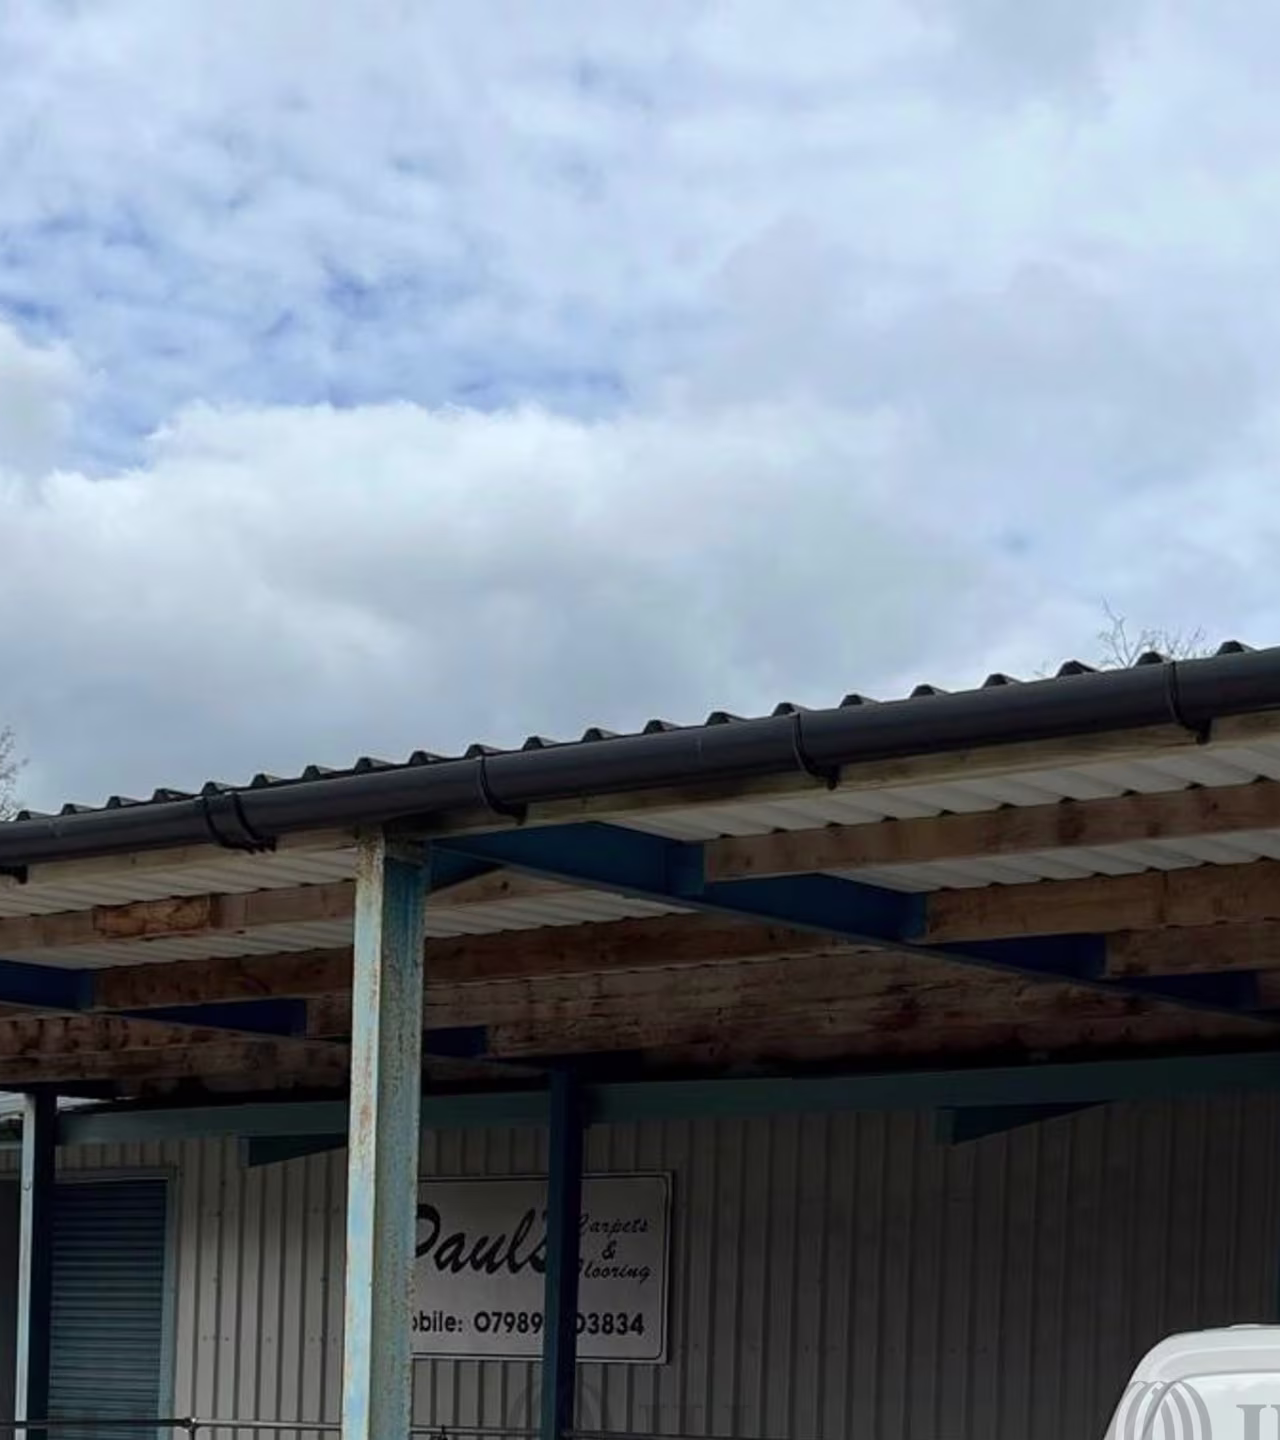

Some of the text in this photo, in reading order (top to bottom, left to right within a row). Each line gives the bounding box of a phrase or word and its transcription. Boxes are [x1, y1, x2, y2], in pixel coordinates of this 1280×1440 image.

[602, 1240, 617, 1259] &
[578, 1258, 651, 1284] looring
[413, 1311, 644, 1335] bile: 07989 03834
